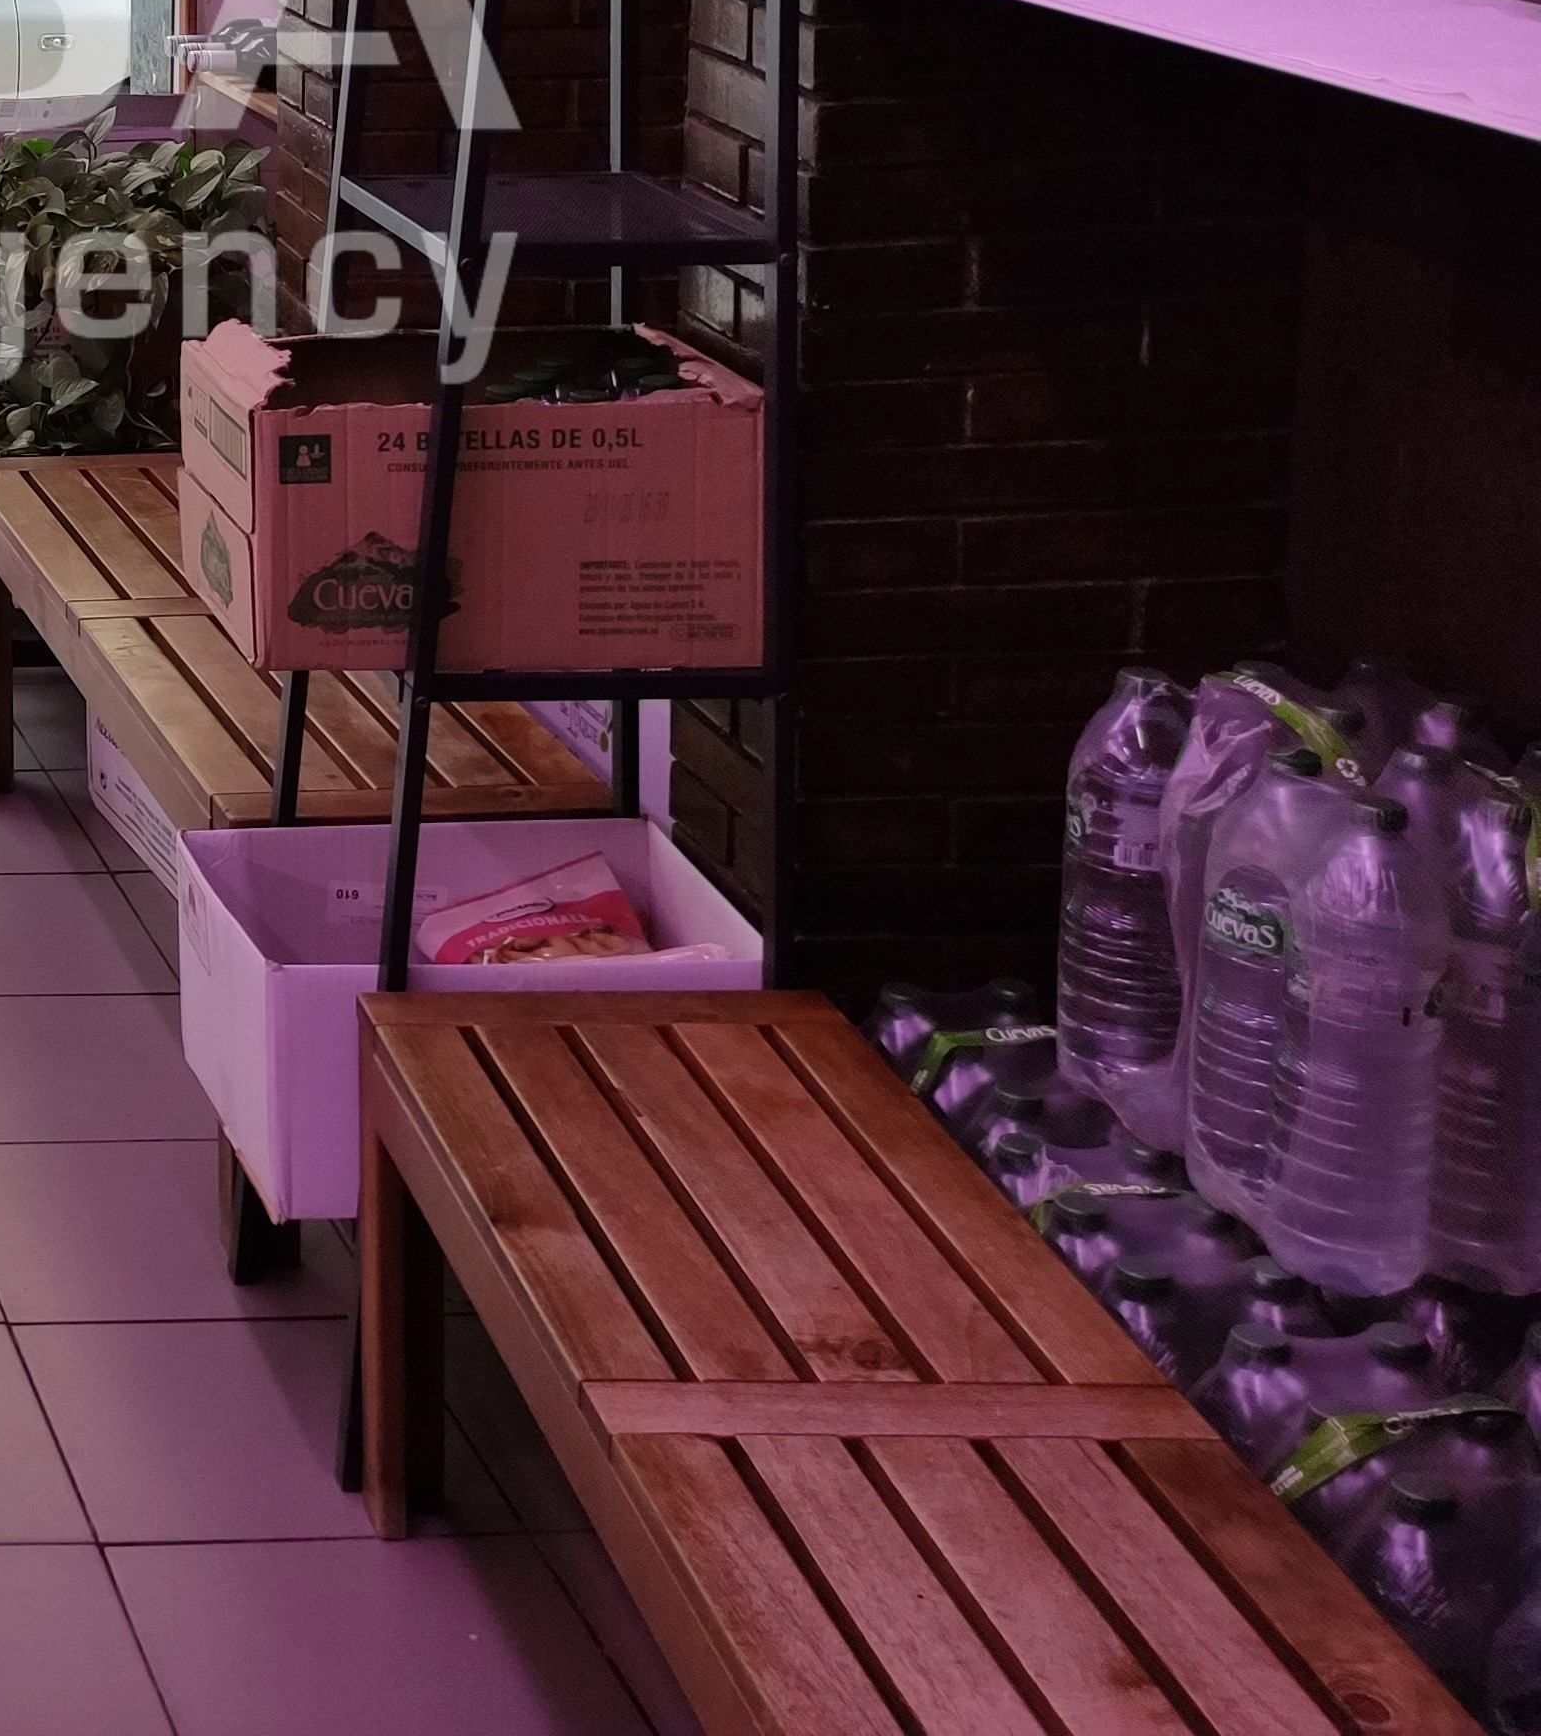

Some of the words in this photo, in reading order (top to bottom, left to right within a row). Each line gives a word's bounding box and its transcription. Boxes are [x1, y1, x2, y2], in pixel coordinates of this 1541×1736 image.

[377, 432, 406, 452] 24
[417, 429, 541, 452] BELLAS
[551, 428, 583, 450] DE
[592, 427, 644, 451] 0,5L
[460, 459, 563, 472] REFERENTEMENTE
